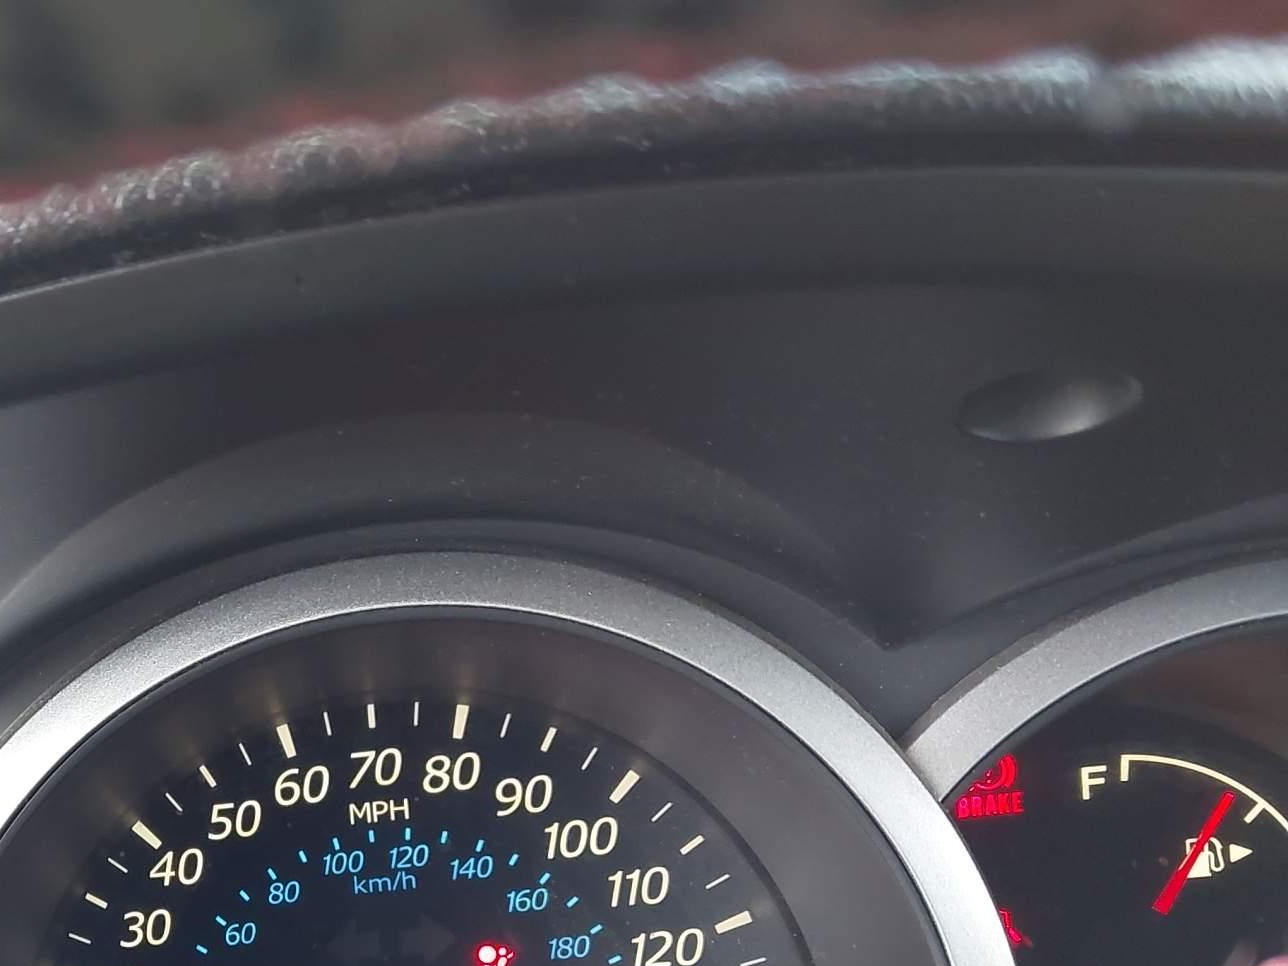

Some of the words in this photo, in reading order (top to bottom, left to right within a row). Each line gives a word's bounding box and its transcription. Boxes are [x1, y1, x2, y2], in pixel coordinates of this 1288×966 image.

[349, 748, 402, 788] 70
[422, 752, 480, 794] 80
[1081, 765, 1107, 800] F
[274, 766, 330, 805] 60
[495, 775, 552, 816] 90
[349, 799, 409, 824] MPH
[956, 791, 1024, 818] BRAKE
[208, 801, 261, 840] 50
[544, 817, 618, 859] 100
[149, 849, 203, 886] 40
[323, 850, 364, 876] 100
[390, 844, 428, 868] 120
[450, 856, 493, 880] 140
[268, 881, 299, 904] 80
[354, 872, 416, 894] km/h
[608, 867, 669, 907] 110
[507, 888, 548, 912] 160
[120, 910, 171, 948] 30
[226, 923, 256, 944] 60
[549, 935, 590, 960] 180
